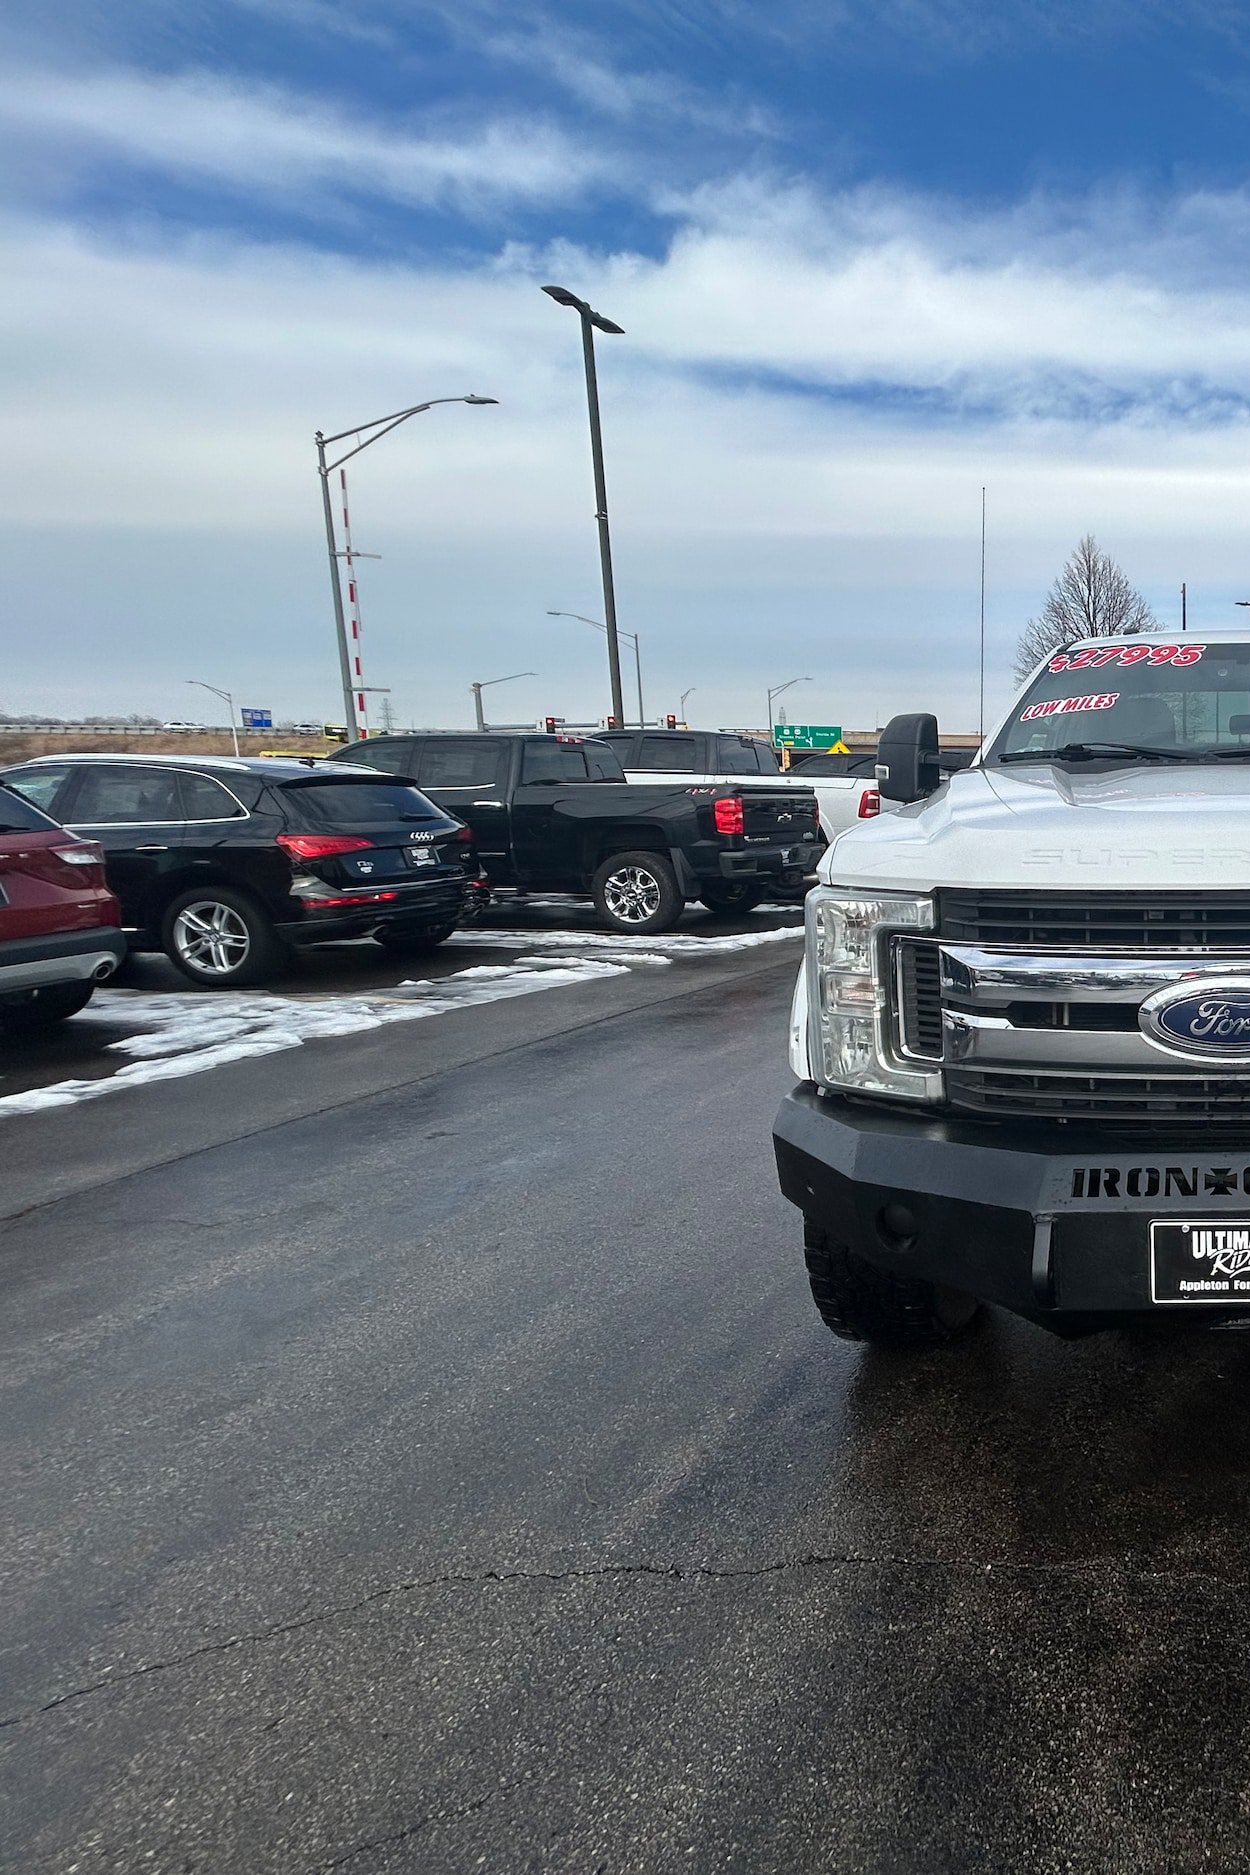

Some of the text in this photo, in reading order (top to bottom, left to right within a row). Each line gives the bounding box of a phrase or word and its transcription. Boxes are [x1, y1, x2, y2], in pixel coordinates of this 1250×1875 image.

[1049, 644, 1206, 673] $27995
[1020, 692, 1120, 721] LOW MILES
[1070, 1166, 1199, 1198] IRON
[1179, 1280, 1230, 1292] Appleton
